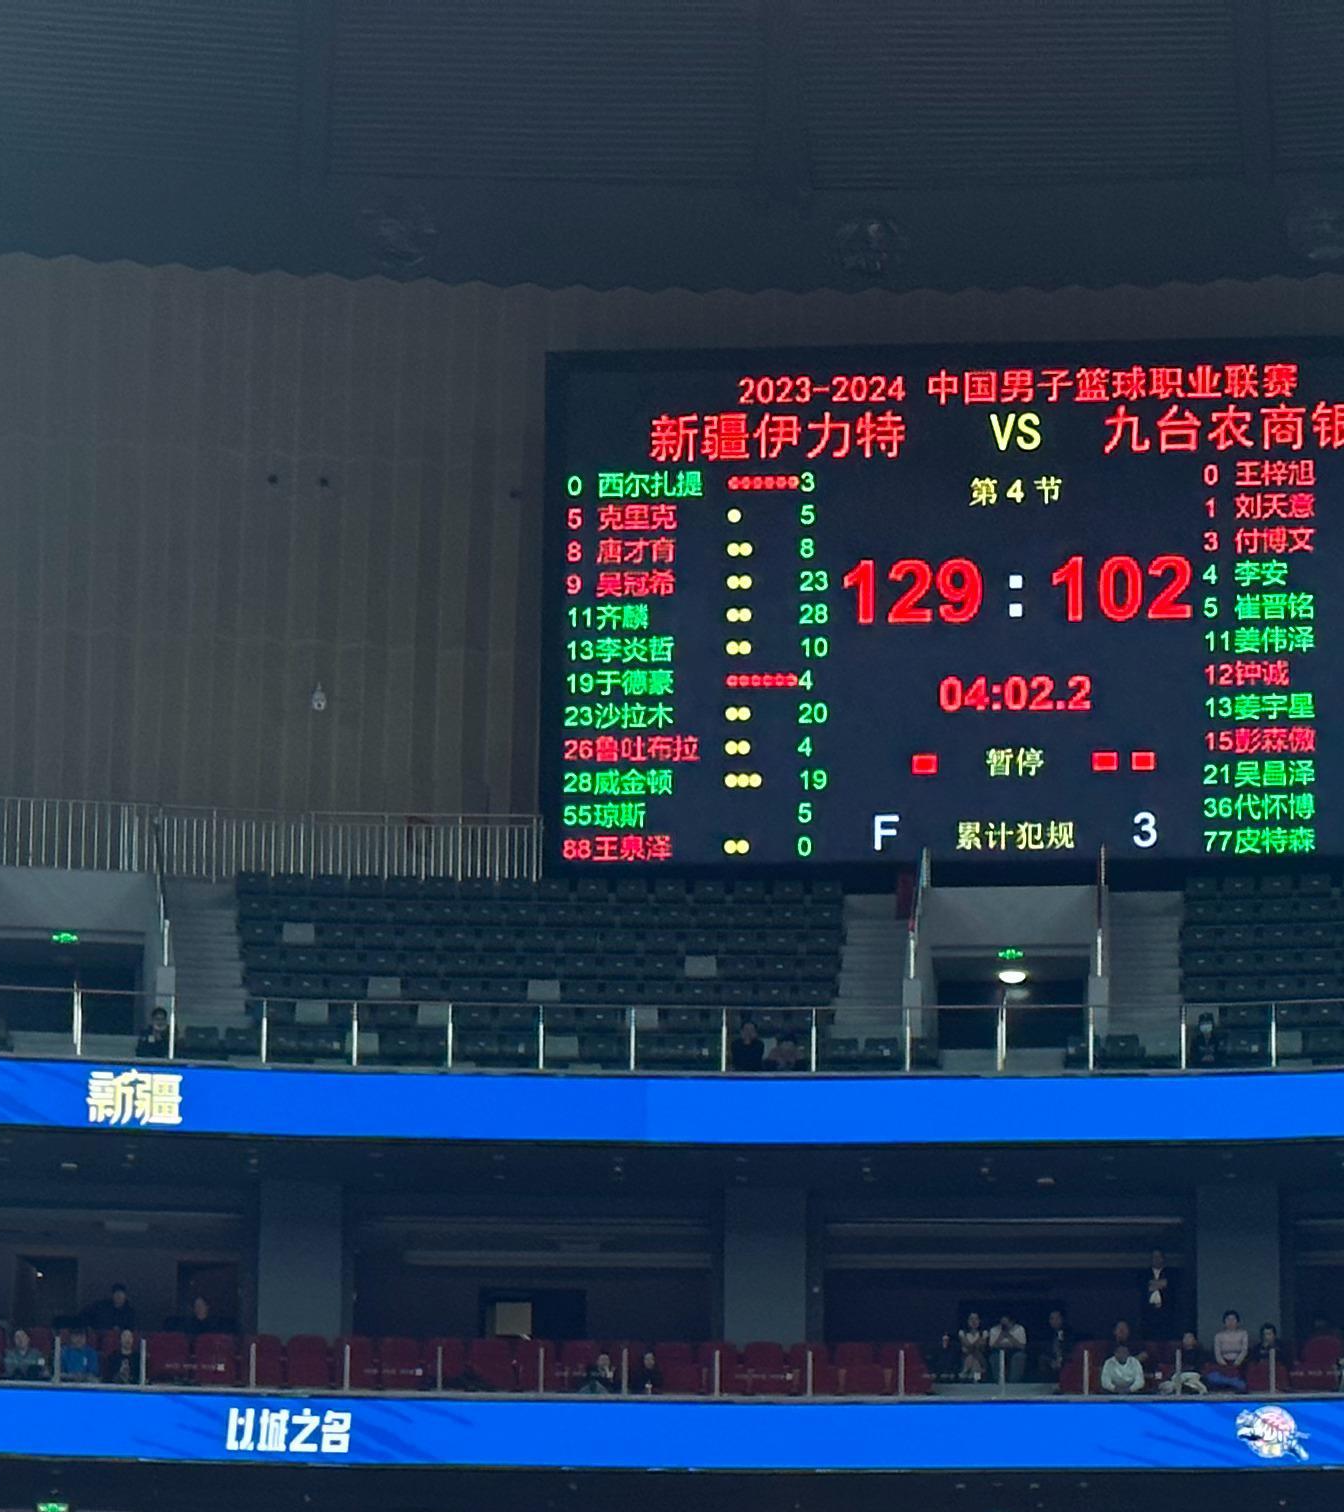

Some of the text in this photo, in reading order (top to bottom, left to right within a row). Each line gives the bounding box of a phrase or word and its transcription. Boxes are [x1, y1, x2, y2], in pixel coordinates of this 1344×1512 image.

[739, 364, 1298, 405] 2023-2024 中国男子篮球职业联赛
[649, 411, 905, 462] 新疆伊力特
[990, 413, 1040, 450] VS
[568, 471, 815, 498] 0 西尔扎提 3
[1204, 465, 1218, 485] 0
[1235, 460, 1316, 487] 王梓旭
[568, 504, 815, 531] 5 克里克 5
[1205, 498, 1215, 518] 1
[1235, 493, 1316, 519] 刘天意
[567, 541, 582, 562] 8
[800, 538, 814, 558] 8
[1204, 532, 1218, 551] 3
[1234, 527, 1316, 554] 付博文
[567, 569, 828, 597] 9 吴冠希 23
[1203, 564, 1218, 584] 4
[1234, 560, 1288, 587] 李安
[844, 558, 983, 625] 129
[1052, 554, 1193, 622] 102
[799, 603, 828, 624] 28
[1204, 597, 1218, 618] 5
[1234, 593, 1315, 620] 崔晋铭
[801, 637, 828, 657] 10
[799, 670, 813, 690] 4
[940, 676, 1091, 712] 04:02.2
[799, 703, 827, 723] 20
[799, 737, 812, 757] 4
[986, 748, 1044, 777] 暂停
[800, 769, 827, 790] 19
[798, 803, 811, 823] 5
[874, 812, 1157, 851] F 累计犯规 3
[798, 836, 811, 856] 0
[86, 1068, 183, 1126] 新疆
[226, 1407, 352, 1454] 以城之名
